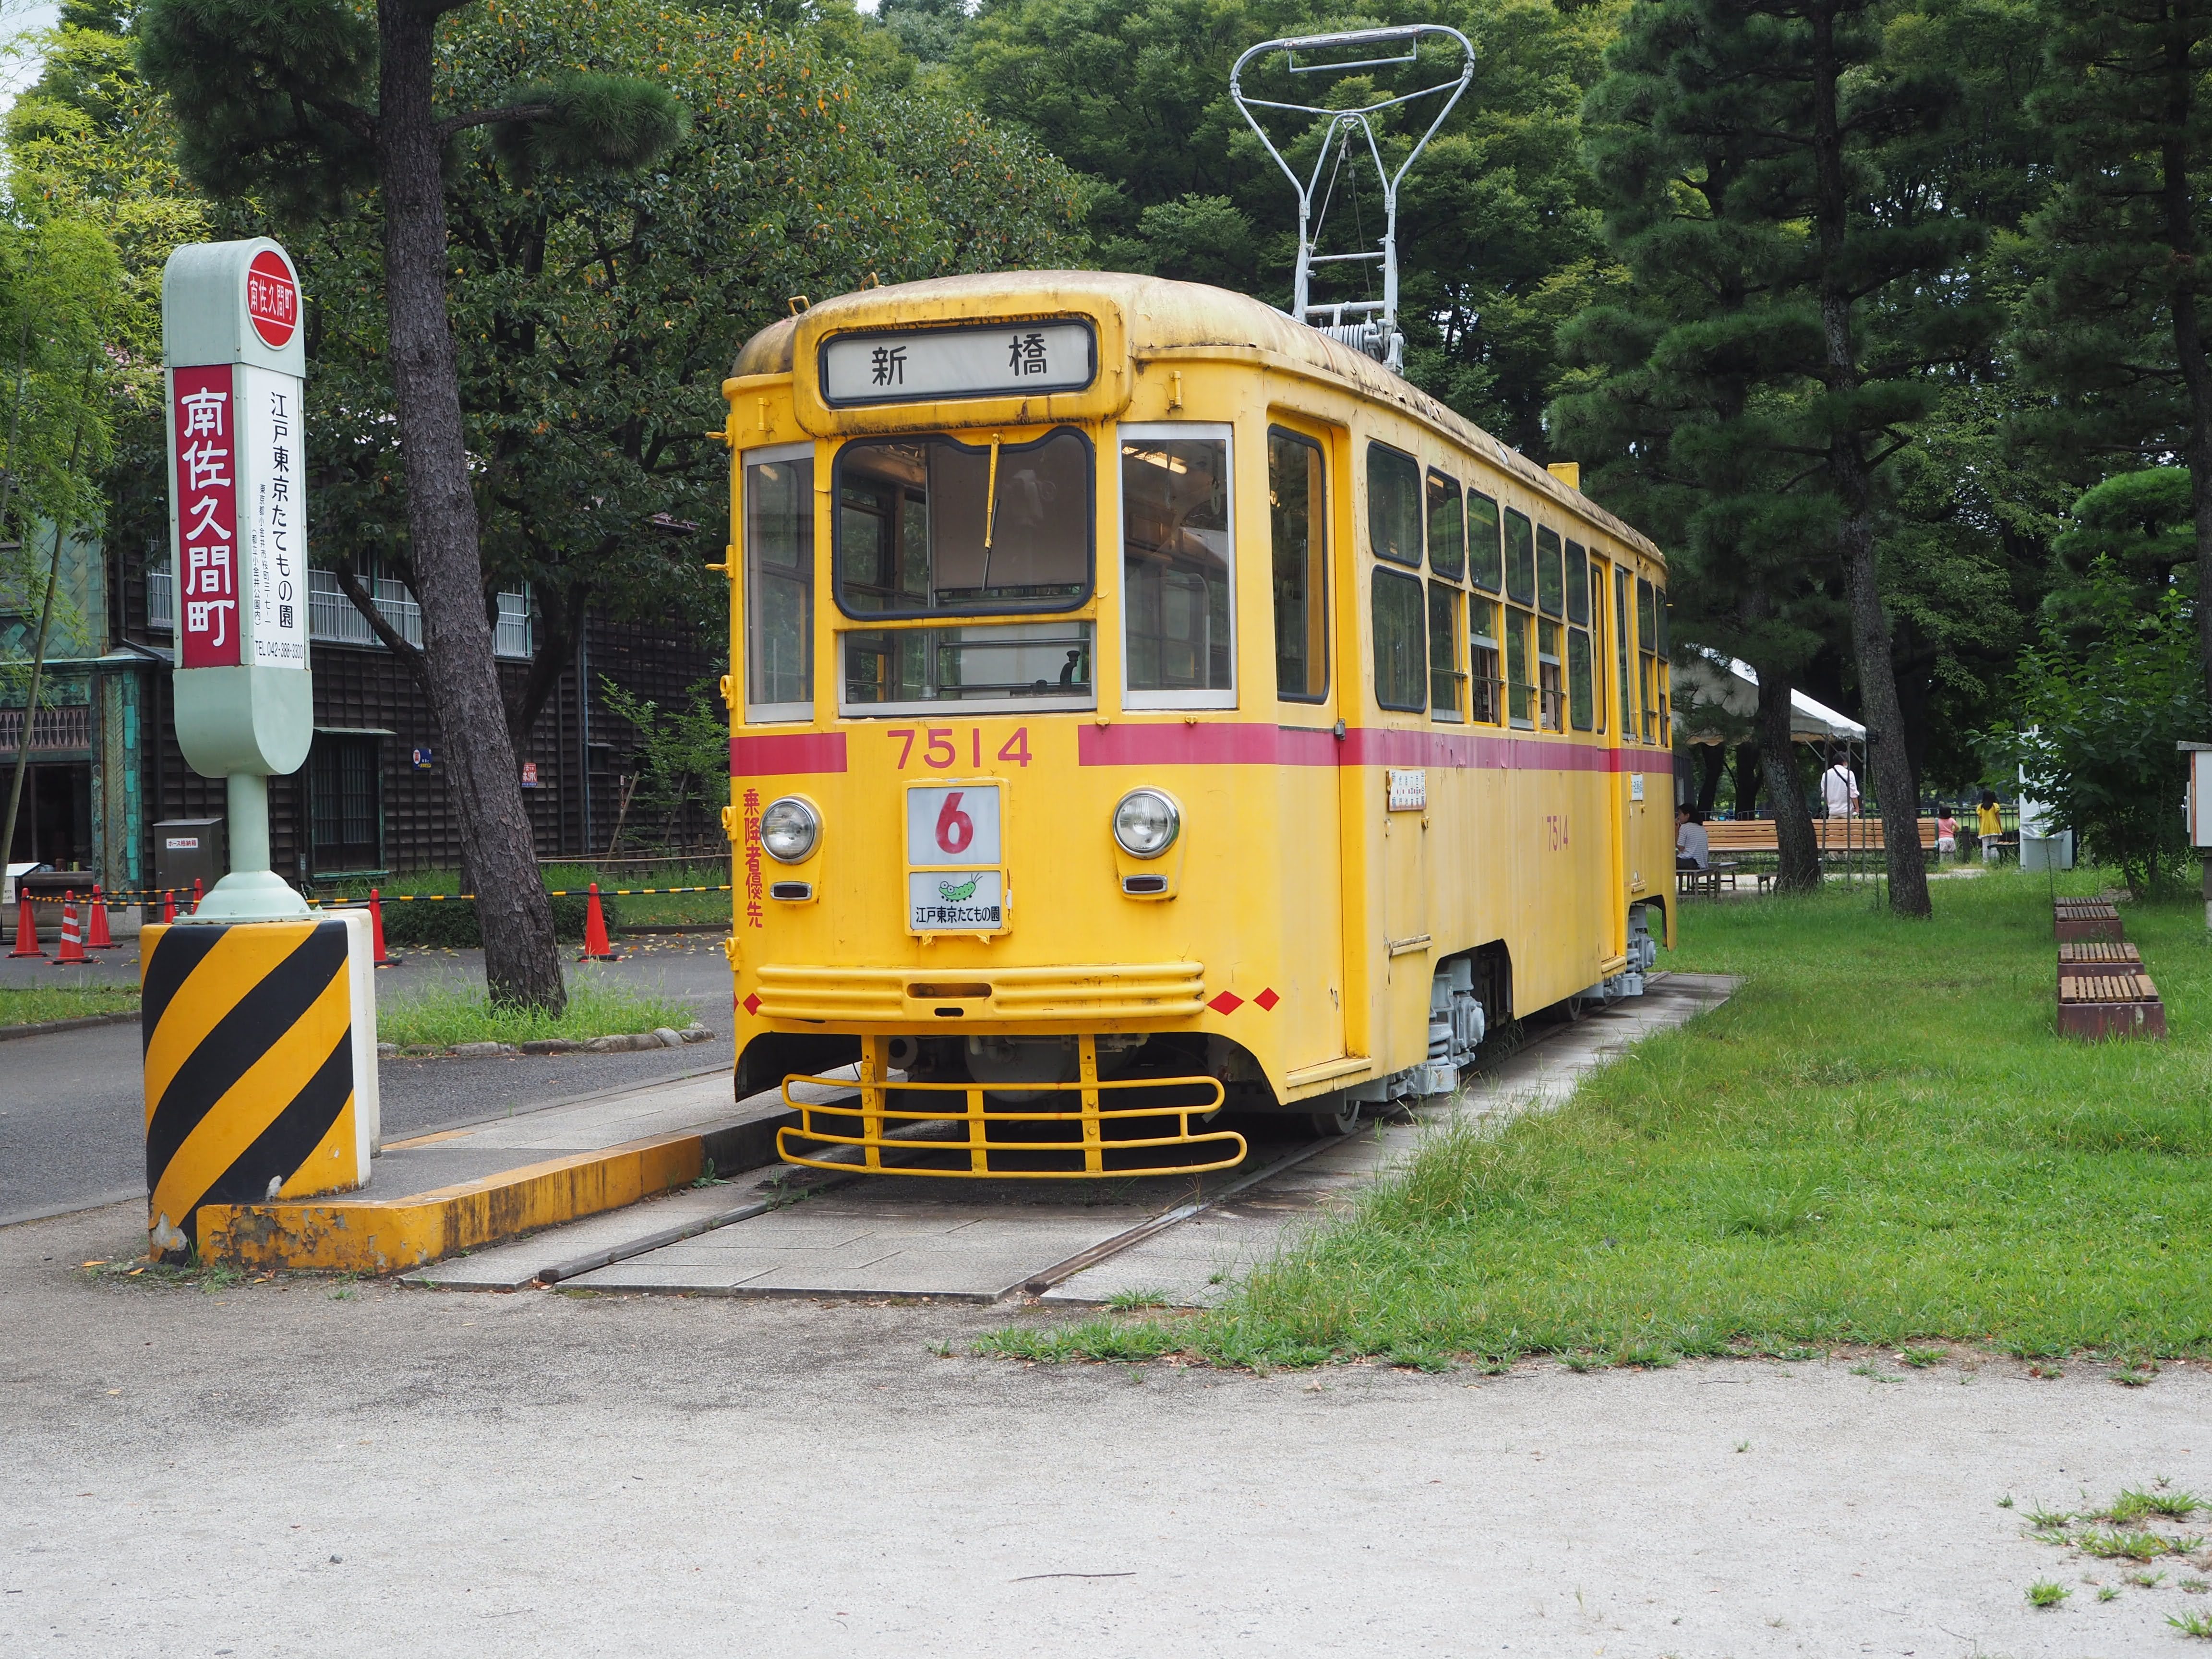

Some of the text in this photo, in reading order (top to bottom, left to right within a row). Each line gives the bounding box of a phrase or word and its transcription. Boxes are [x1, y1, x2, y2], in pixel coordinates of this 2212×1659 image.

[250, 277, 293, 321] 南佐久間町
[181, 387, 235, 647] 南佐久間町
[271, 392, 293, 629] 江戸東京たてもの園
[255, 640, 266, 656] TEL
[887, 727, 1032, 770] 7514
[935, 793, 974, 854] 6
[1546, 815, 1568, 852] 7514
[743, 788, 763, 929] 乗降者優先
[915, 905, 1000, 924] 江戸東京たてもの園
